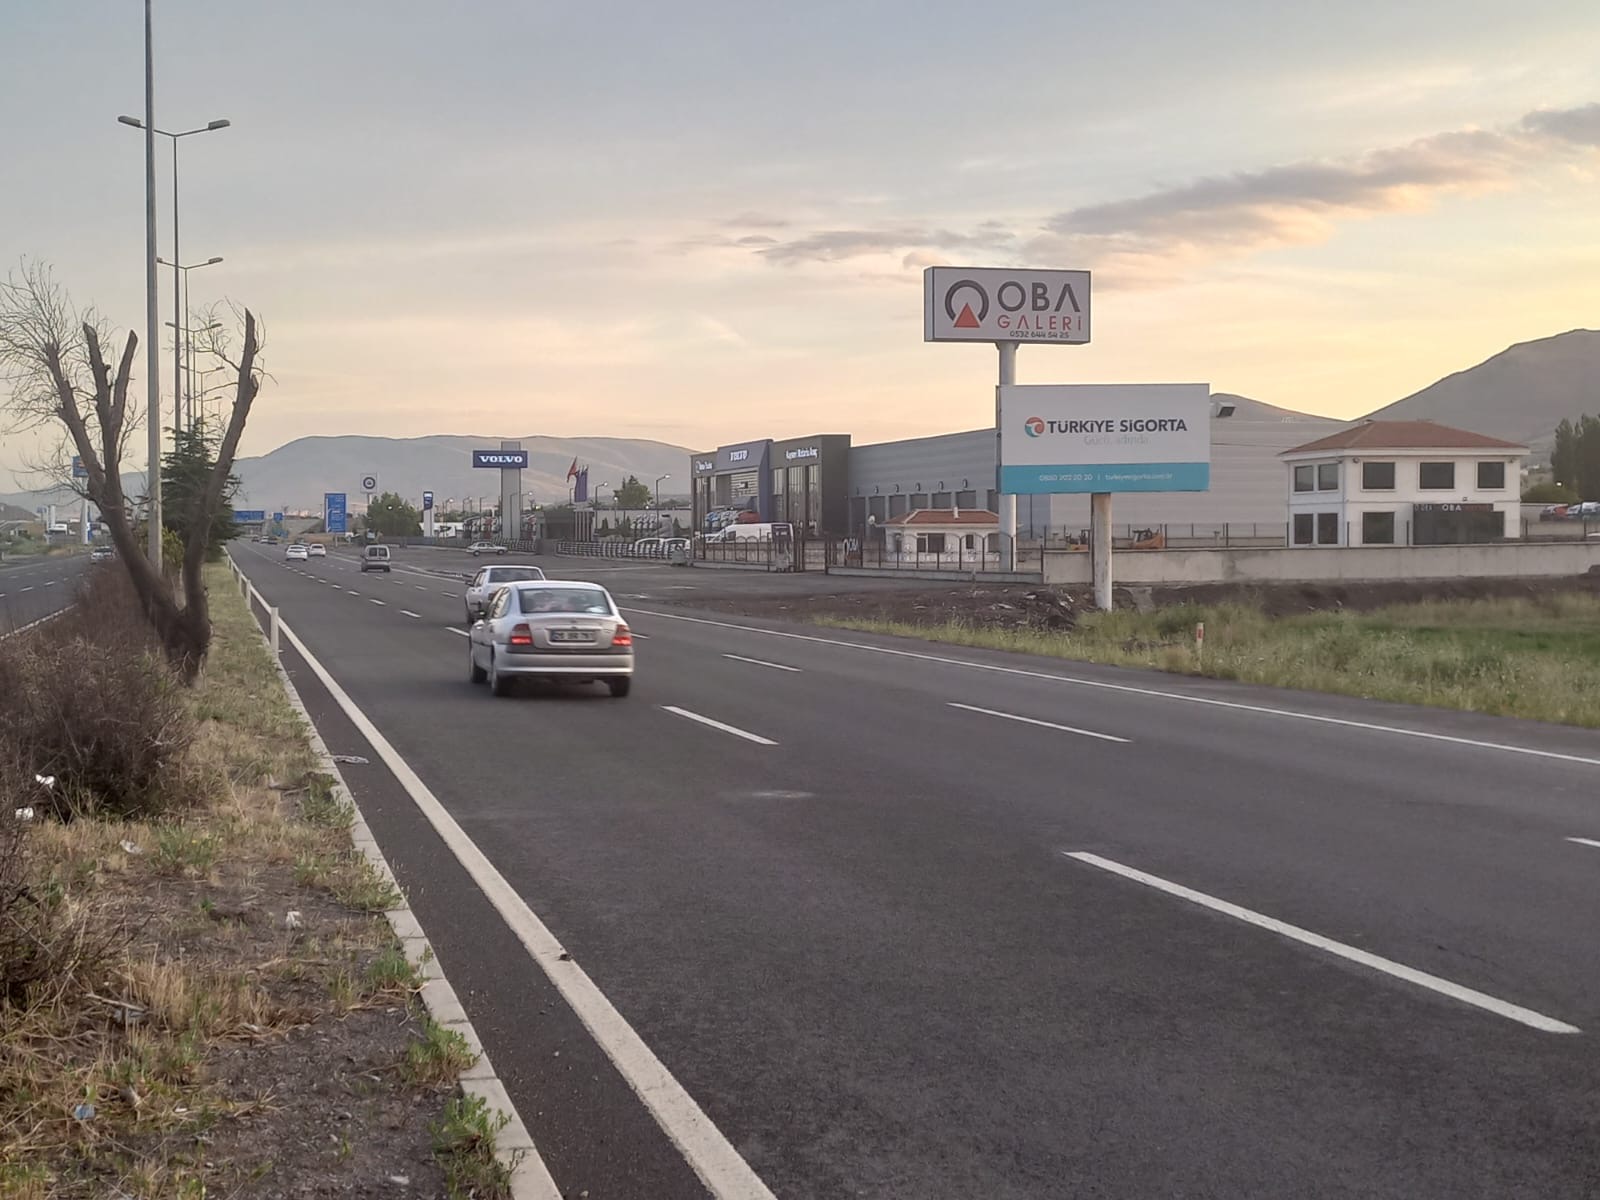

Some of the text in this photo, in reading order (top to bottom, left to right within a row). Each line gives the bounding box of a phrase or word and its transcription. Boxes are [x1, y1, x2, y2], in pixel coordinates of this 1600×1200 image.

[997, 281, 1081, 312] OBA
[997, 314, 1081, 331] GALERİ
[1047, 418, 1188, 434] TÜRKİYE SİGORTA
[479, 455, 523, 463] VOLVO
